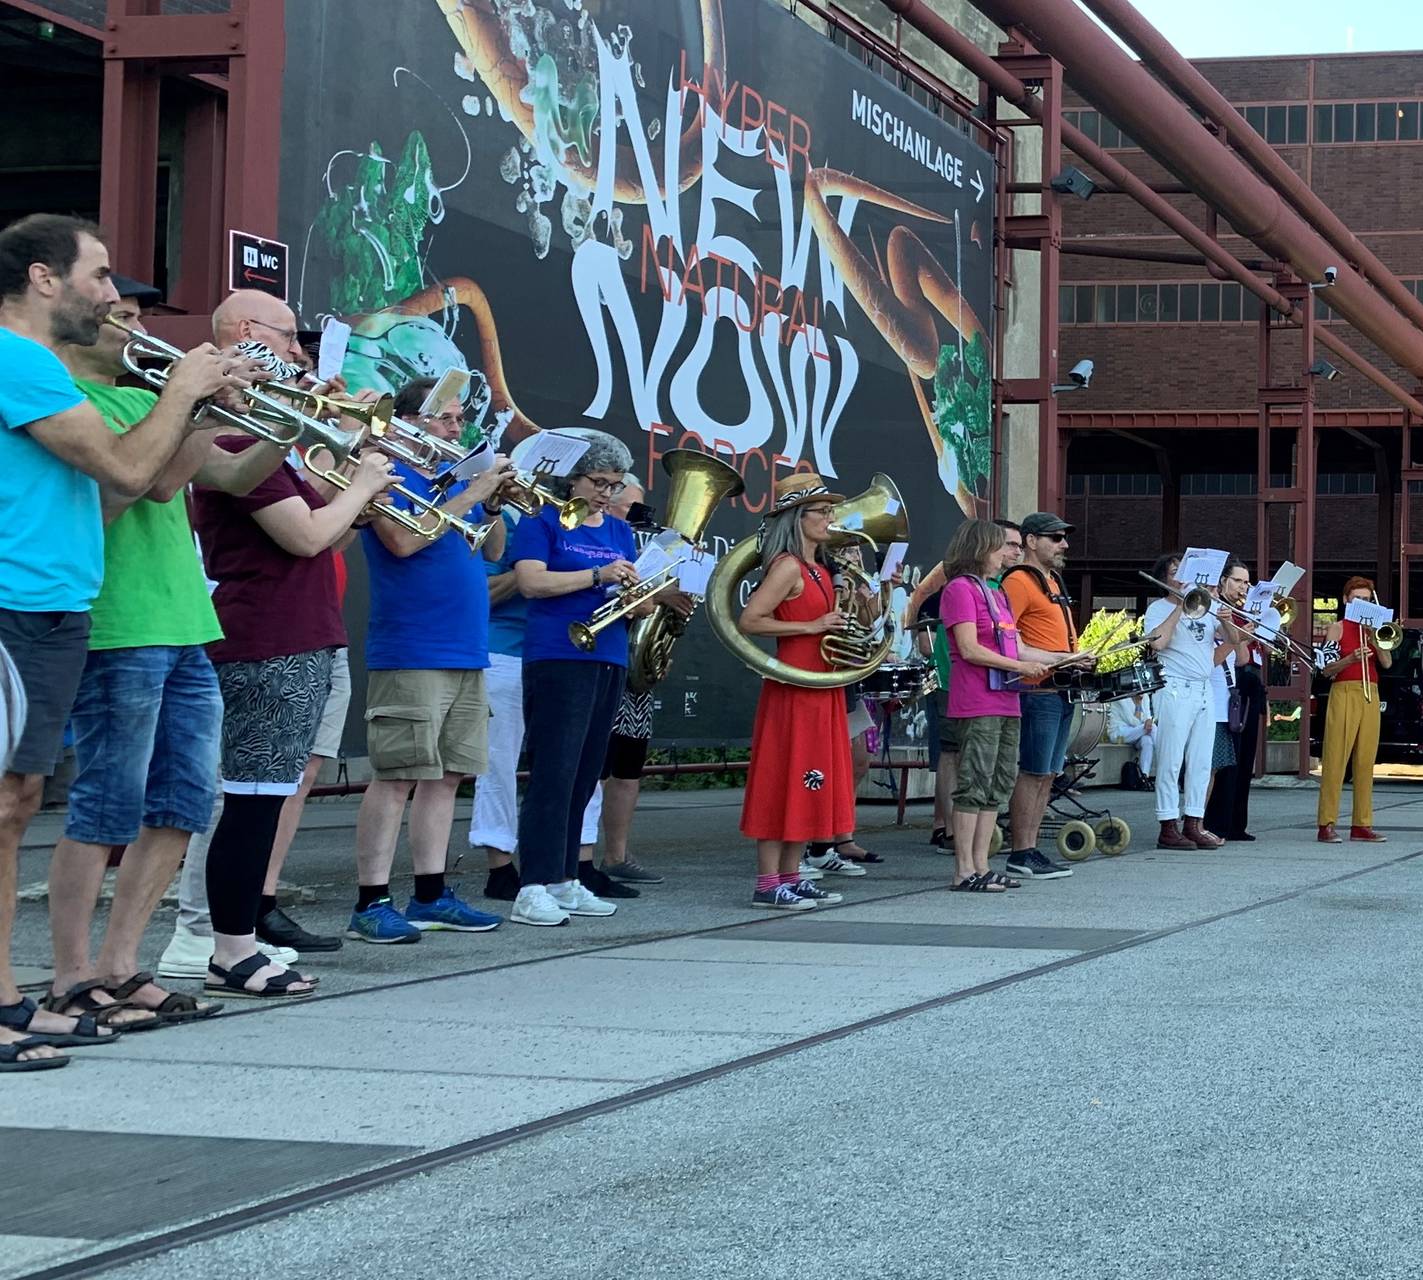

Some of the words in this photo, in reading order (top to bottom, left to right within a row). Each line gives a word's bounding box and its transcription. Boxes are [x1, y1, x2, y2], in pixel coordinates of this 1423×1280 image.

[679, 48, 812, 182] HYPER
[851, 89, 963, 188] MISCHANLAGE
[260, 253, 279, 271] WC
[640, 223, 831, 362] NATURAL
[571, 238, 859, 480] NOW
